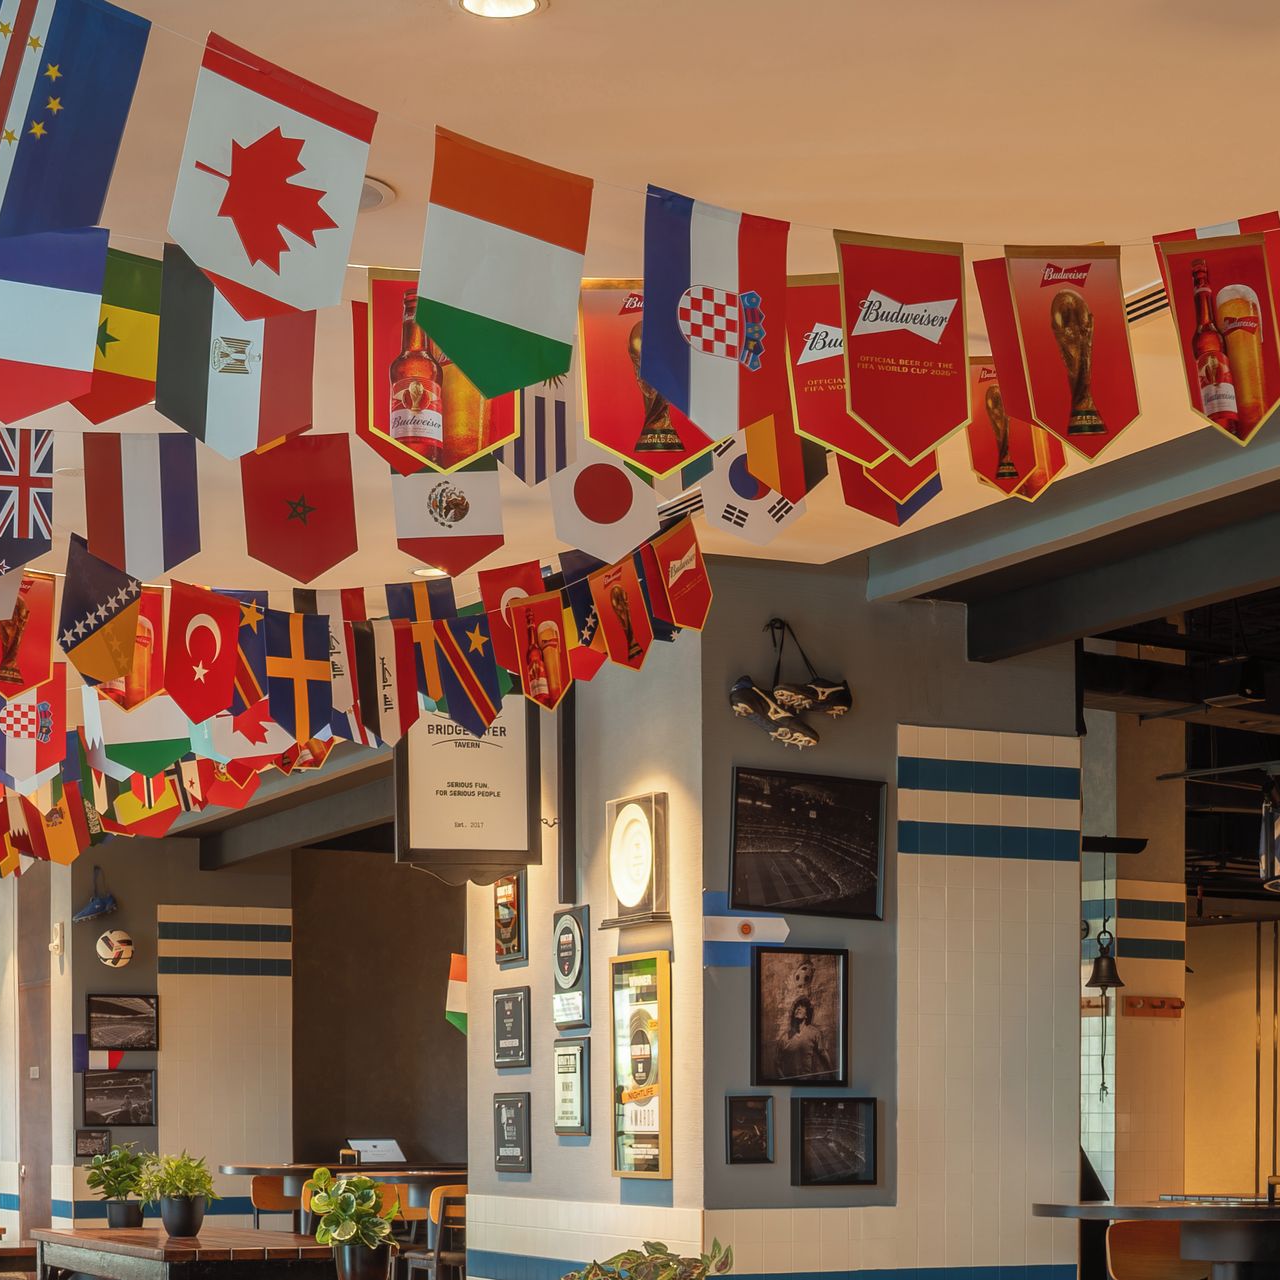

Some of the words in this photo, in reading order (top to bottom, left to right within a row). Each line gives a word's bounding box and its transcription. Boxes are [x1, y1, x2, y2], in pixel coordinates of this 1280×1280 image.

[1041, 268, 1088, 280] Budweiser
[859, 300, 948, 327] Budweiser
[860, 355, 896, 365] OFFICIAL
[899, 358, 920, 366] BEER
[857, 362, 874, 370] FIFA
[878, 364, 908, 373] WORLD
[911, 367, 928, 375] CUP
[392, 416, 441, 430] Budweiser
[454, 741, 480, 749] TAVERN
[628, 1087, 653, 1100] NIGHTLIFE
